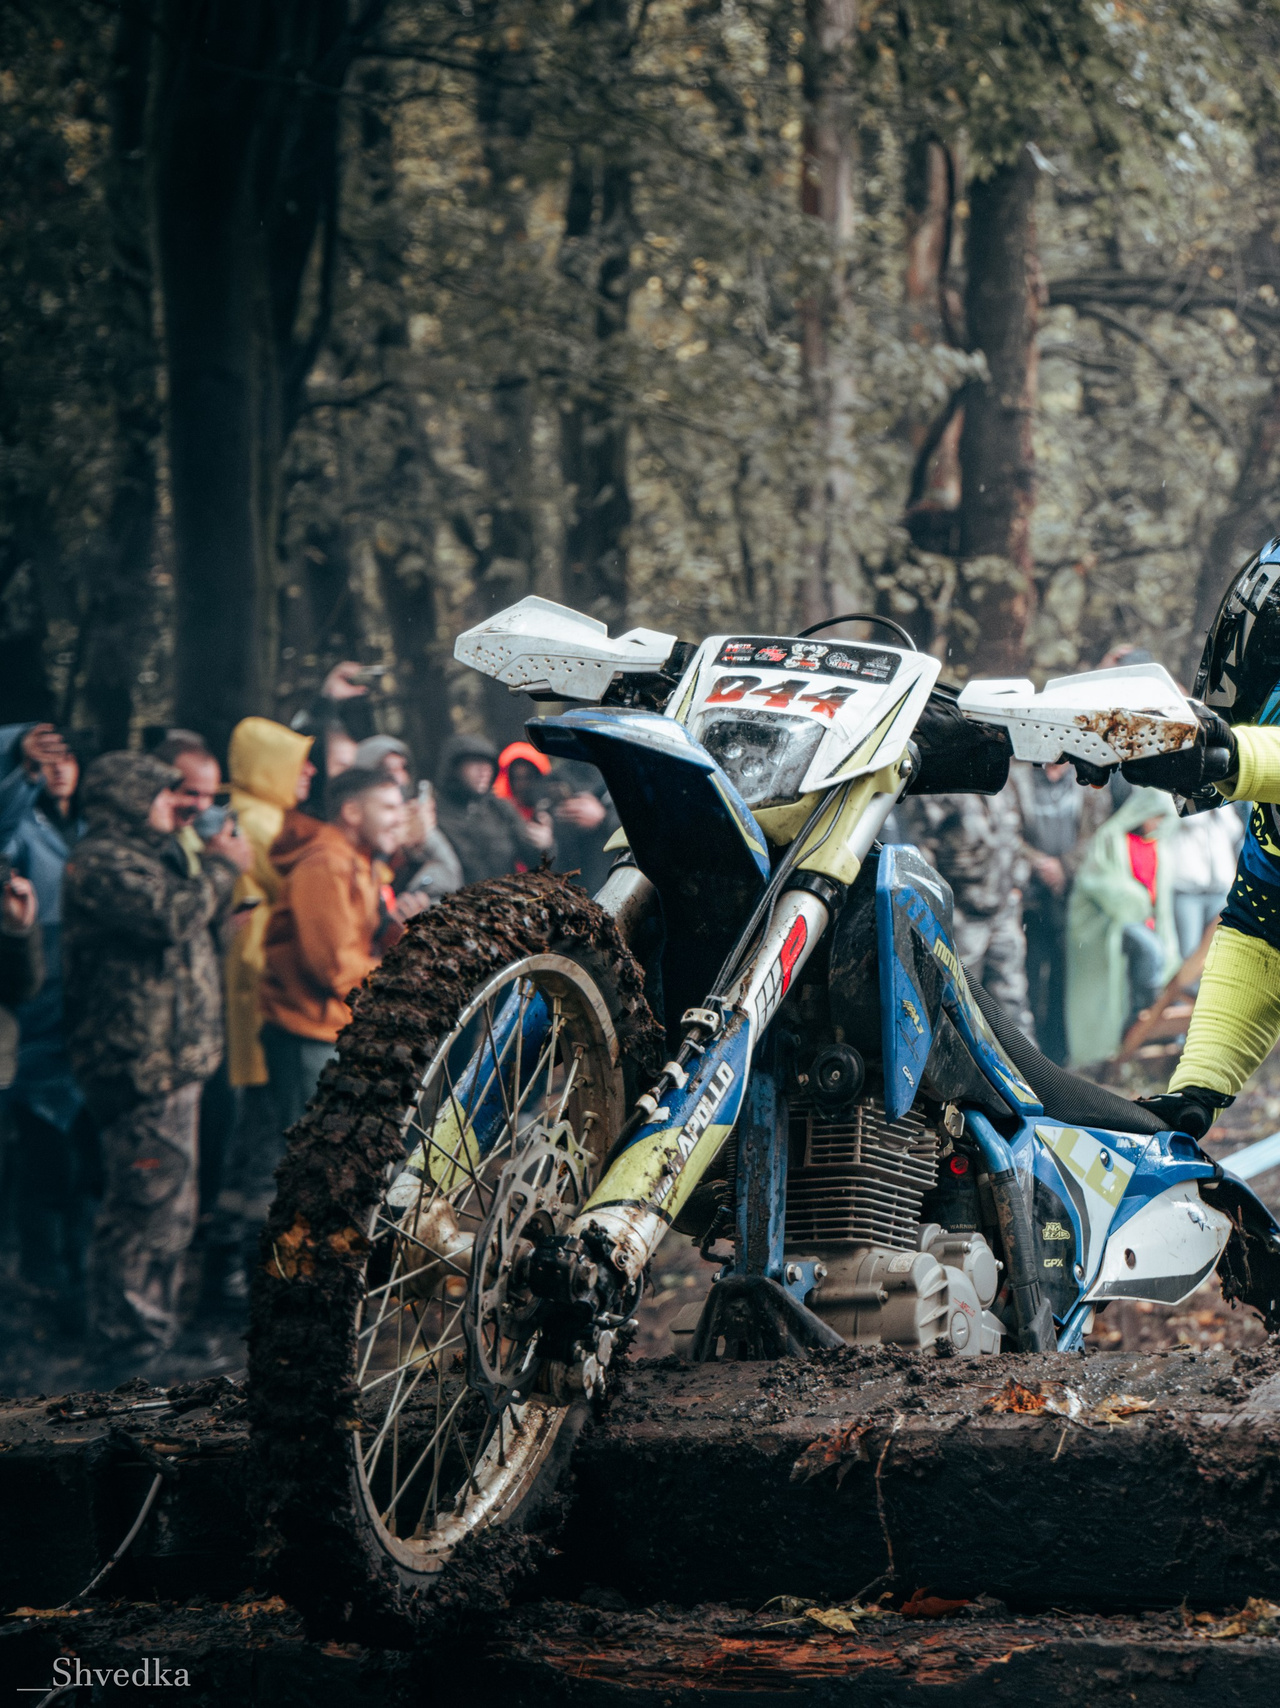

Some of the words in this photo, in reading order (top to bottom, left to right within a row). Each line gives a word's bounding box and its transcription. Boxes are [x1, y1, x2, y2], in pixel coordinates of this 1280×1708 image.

[704, 675, 858, 719] 044
[676, 1060, 736, 1162] APOLLO
[1043, 1258, 1064, 1268] GPX
